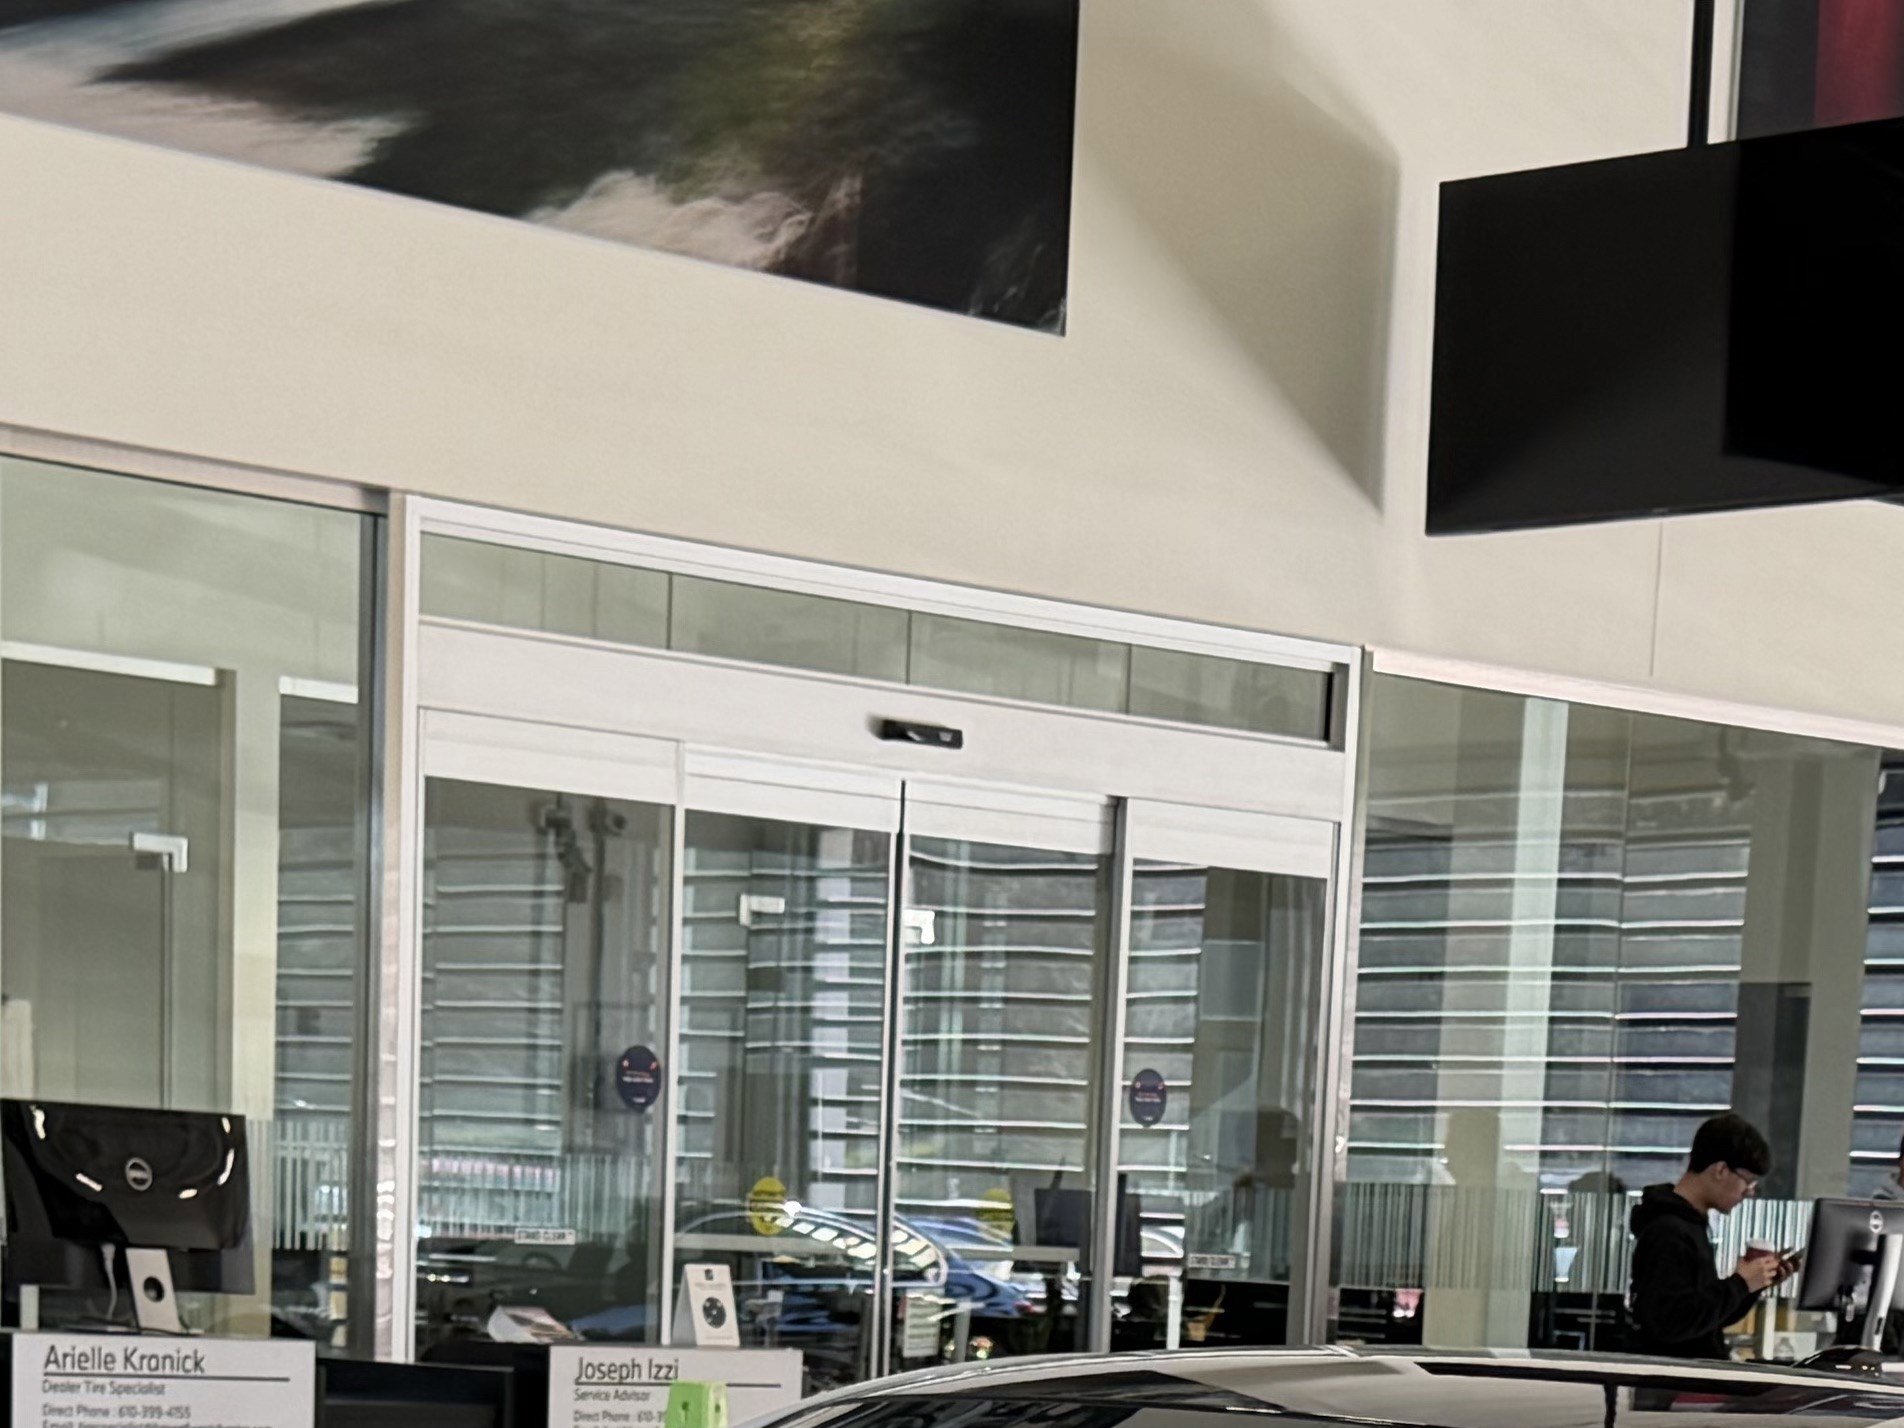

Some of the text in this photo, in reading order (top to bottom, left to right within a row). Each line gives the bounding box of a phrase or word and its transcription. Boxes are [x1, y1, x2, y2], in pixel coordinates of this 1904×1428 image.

[43, 1344, 206, 1374] Arielle Kranick
[575, 1356, 679, 1384] Joseph Izzi
[42, 1380, 166, 1397] Dealer Tire Specialist
[573, 1388, 651, 1401] Service Advisor
[77, 1405, 110, 1418] Phone
